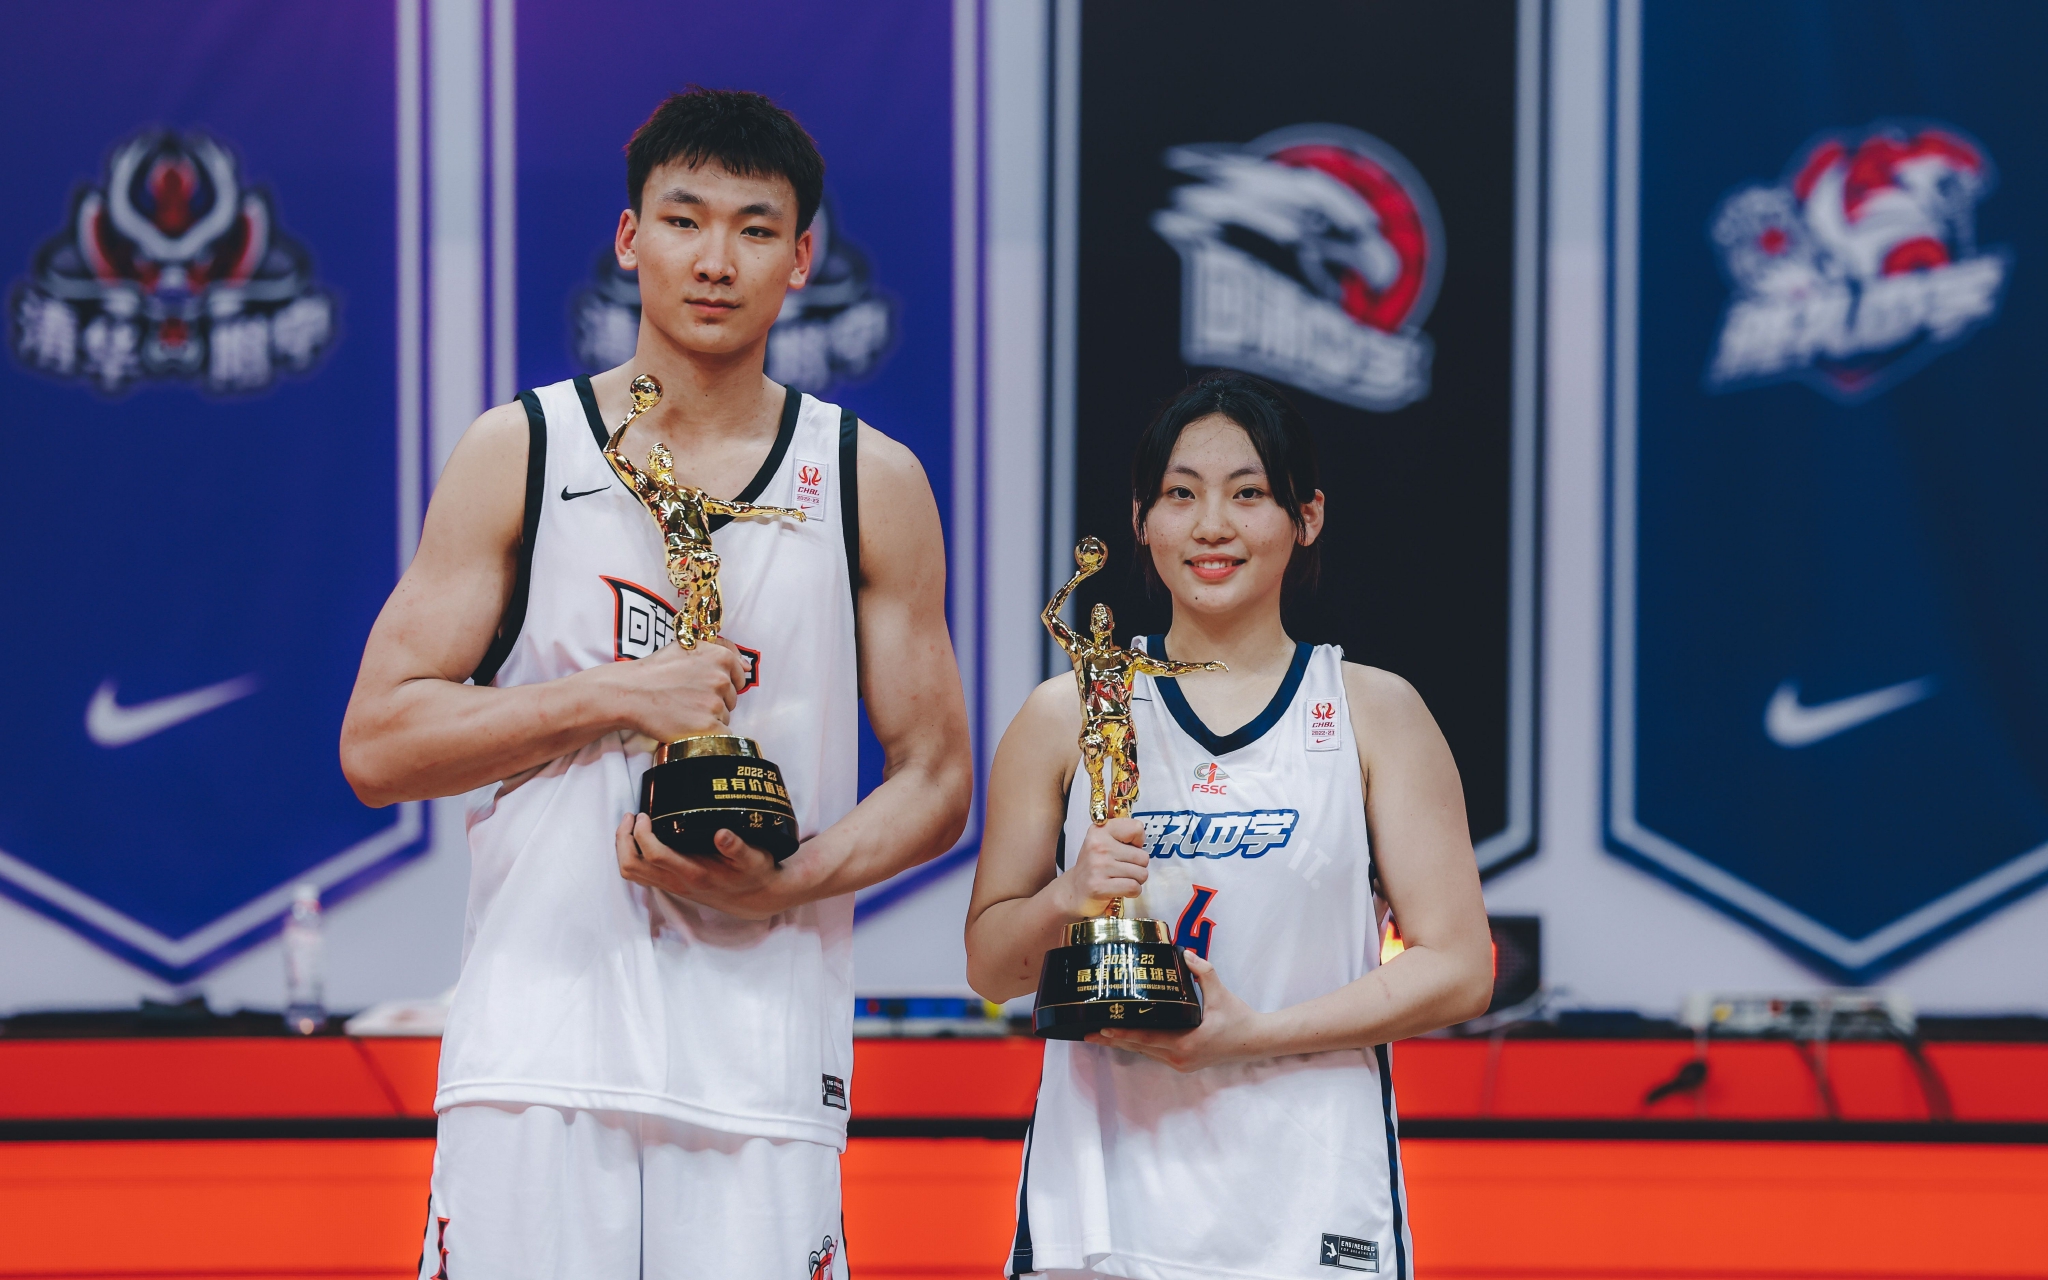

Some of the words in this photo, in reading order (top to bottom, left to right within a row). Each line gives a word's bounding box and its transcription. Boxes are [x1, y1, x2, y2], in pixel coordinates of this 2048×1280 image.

[798, 487, 820, 496] CHBL
[712, 778, 791, 800] 最有价值球
[1192, 784, 1227, 795] FSSC
[1172, 884, 1218, 961] 4
[1104, 954, 1155, 965] 2022-23
[1077, 967, 1178, 983] 最有价值球员
[1341, 1241, 1376, 1252] ENGINEERED
